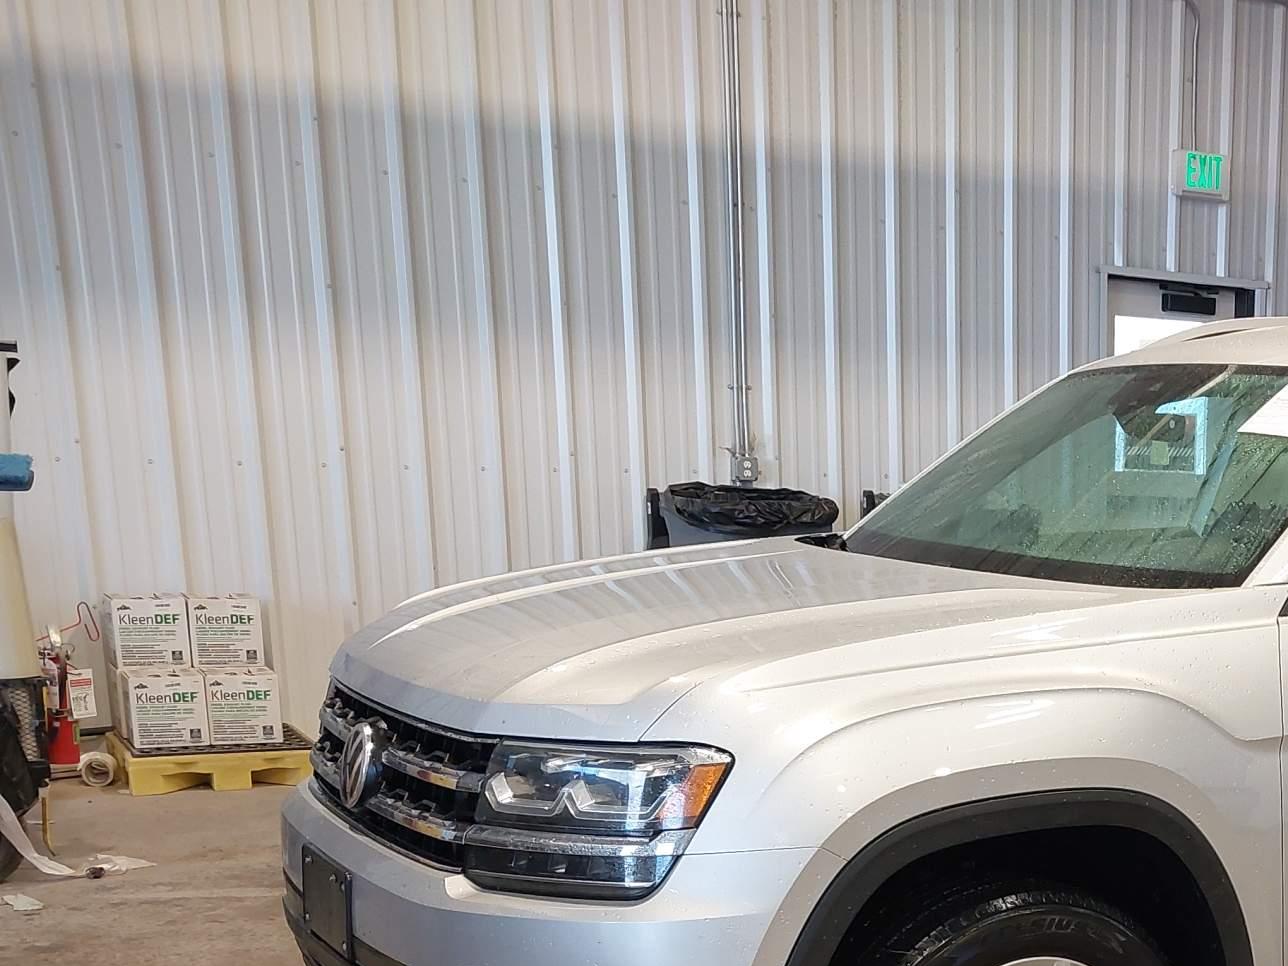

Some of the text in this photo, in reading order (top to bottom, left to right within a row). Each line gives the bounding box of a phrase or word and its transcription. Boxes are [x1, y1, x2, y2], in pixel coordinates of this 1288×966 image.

[1185, 152, 1223, 190] EXIT
[118, 613, 181, 626] KleenDEF
[195, 613, 255, 625] KleenDEF
[135, 690, 200, 705] KleenDEF
[210, 688, 272, 701] KleenDEF
